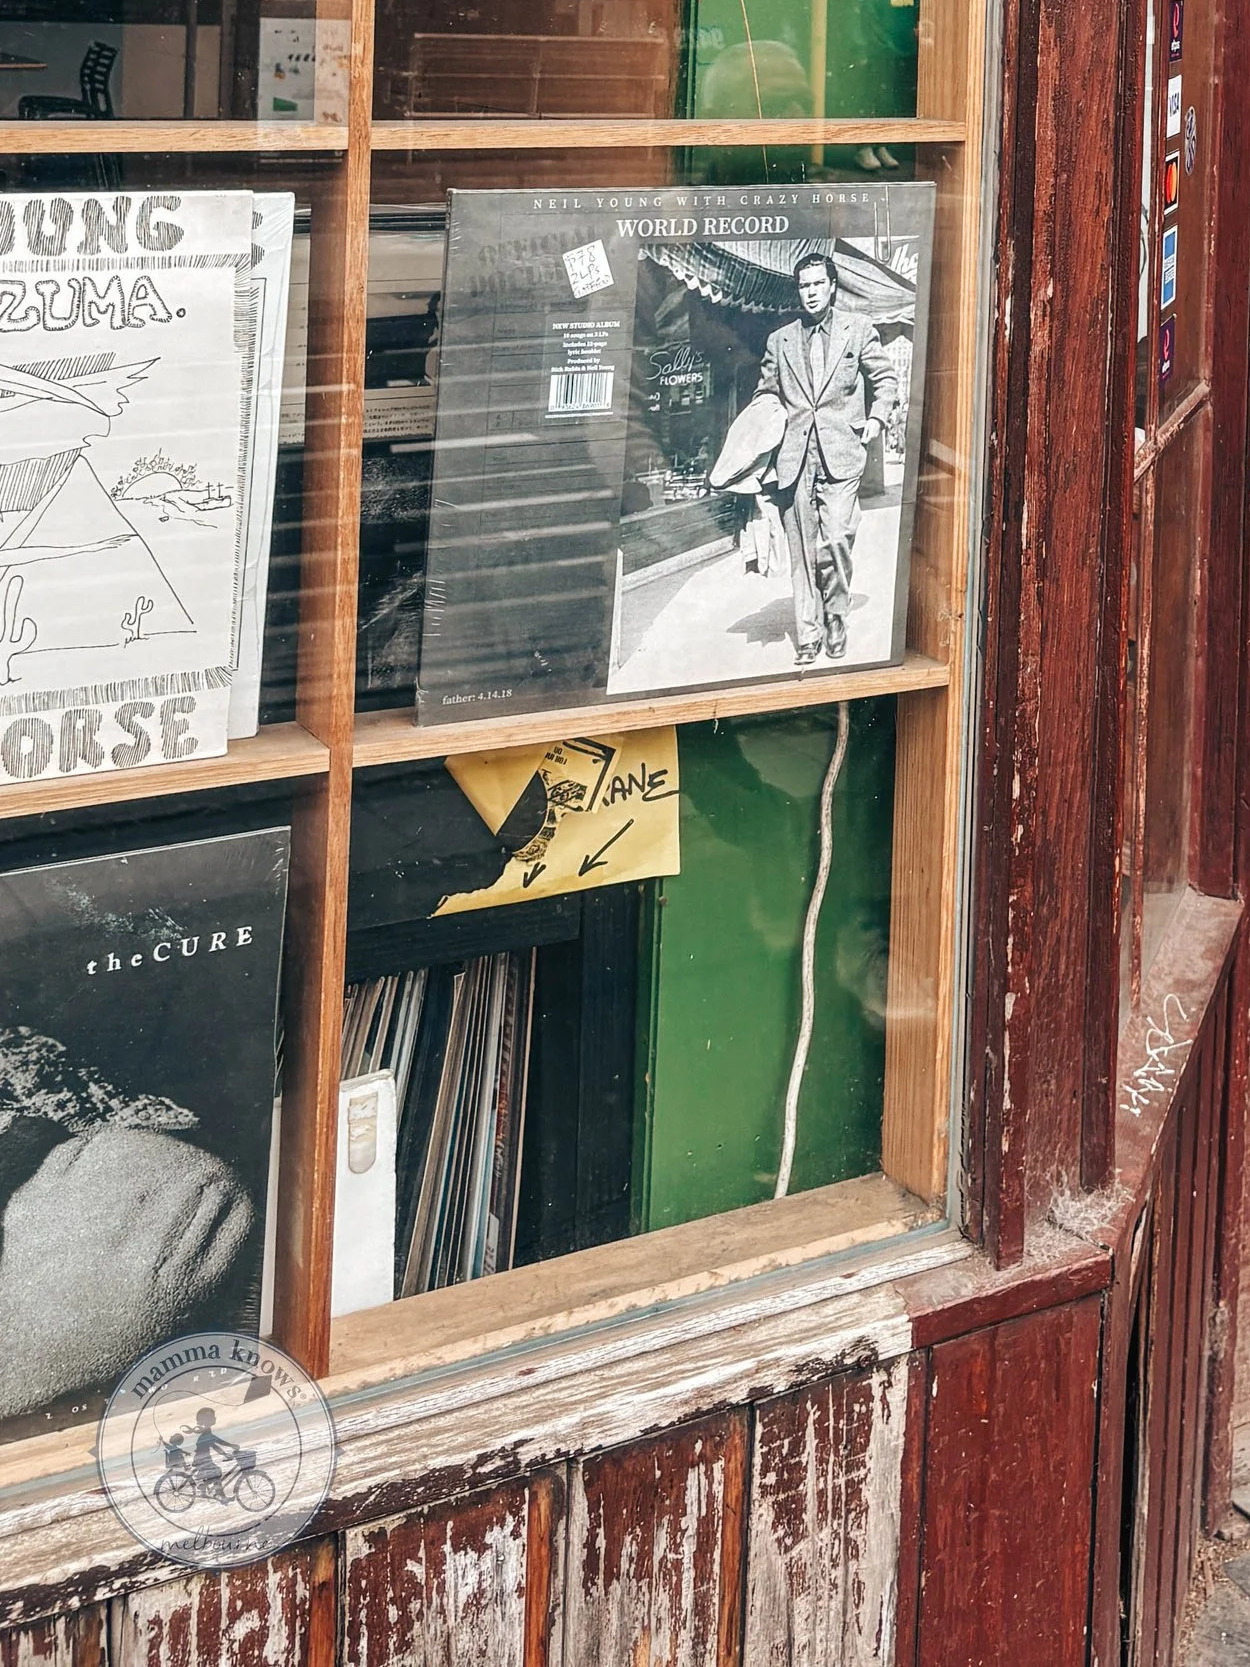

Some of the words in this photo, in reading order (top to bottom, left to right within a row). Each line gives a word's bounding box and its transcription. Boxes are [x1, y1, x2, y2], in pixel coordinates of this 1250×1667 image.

[1168, 91, 1180, 118] VISA
[533, 197, 582, 209] NEIL
[596, 196, 663, 209] YOUNG
[676, 195, 727, 207] WITH
[740, 194, 800, 205] CRAZY
[812, 192, 870, 204] HORSE
[0, 196, 184, 256] UNG
[617, 217, 698, 239] WORLD
[702, 215, 790, 236] RECORD
[552, 322, 569, 330] NEW
[569, 322, 595, 330] STUDIO
[595, 321, 620, 329] ALBUM
[646, 346, 703, 380] Sally's
[660, 372, 703, 385] FLOWERS
[442, 692, 476, 705] father:
[477, 688, 512, 700] 4.14.18
[602, 763, 680, 806] ANE
